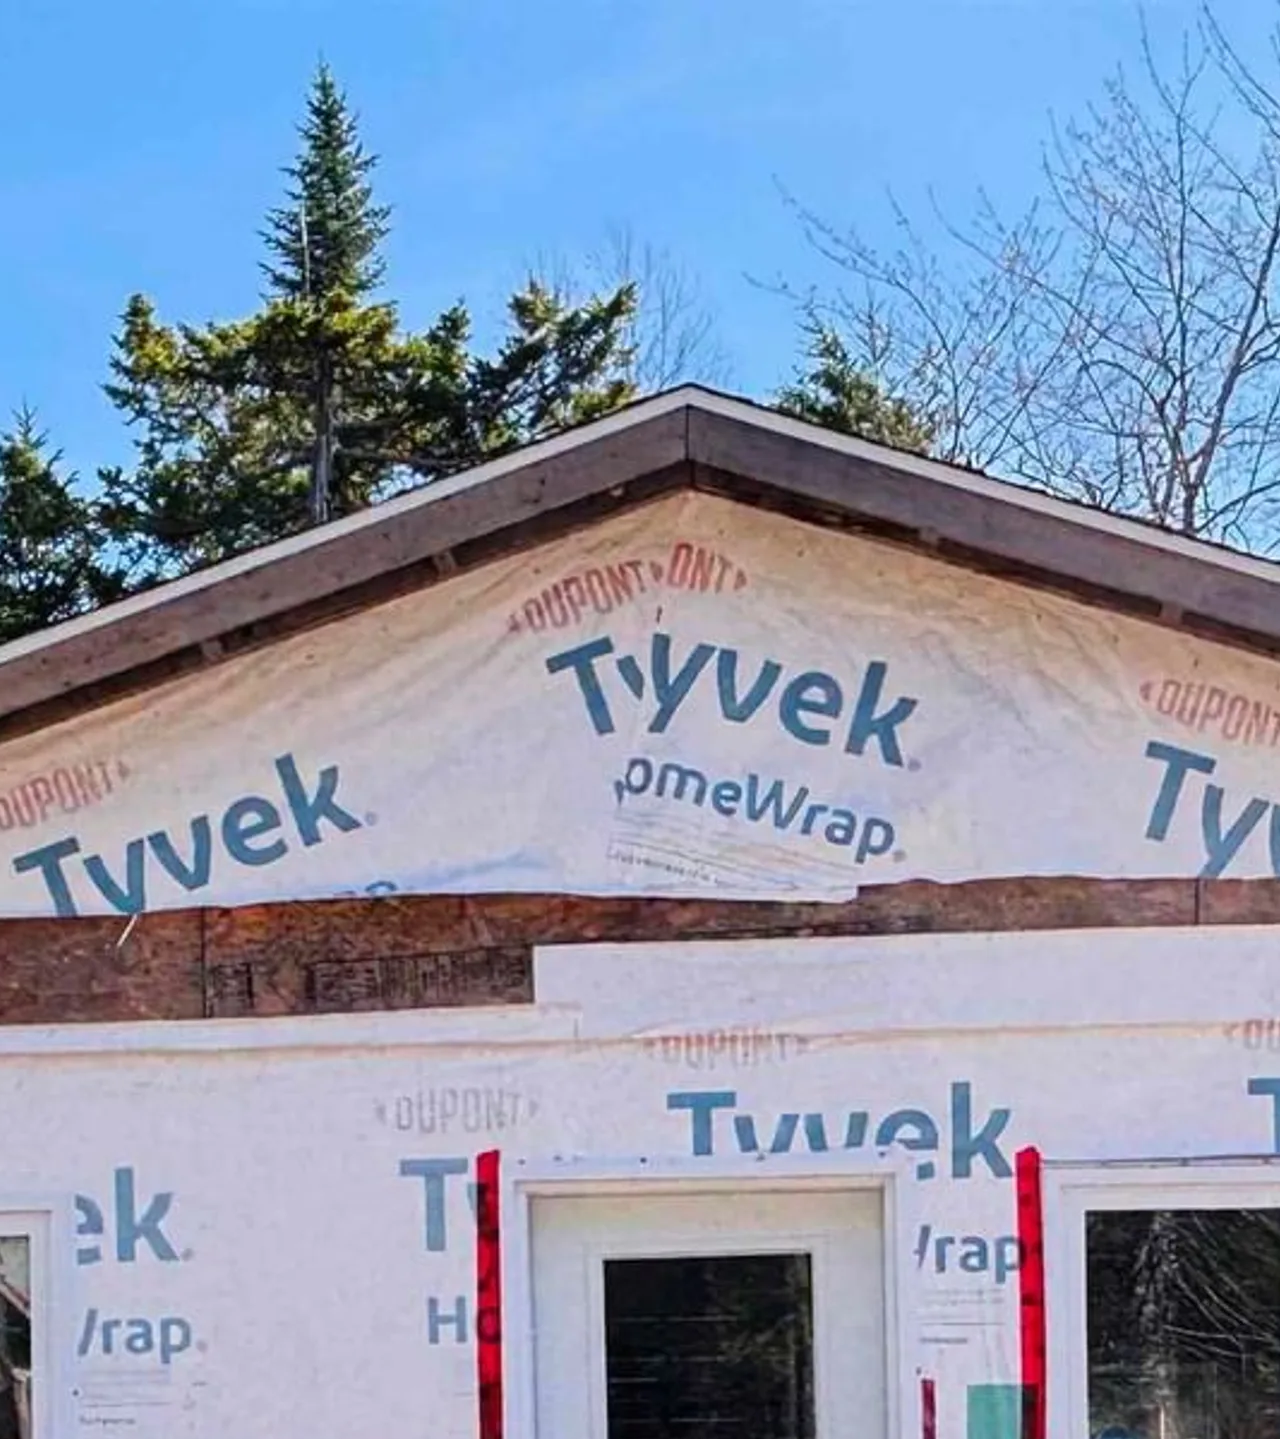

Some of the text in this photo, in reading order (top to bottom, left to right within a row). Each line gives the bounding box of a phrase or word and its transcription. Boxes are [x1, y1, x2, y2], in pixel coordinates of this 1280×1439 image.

[524, 558, 650, 634] DUPONT
[545, 632, 918, 767] Tyvek
[13, 752, 362, 918] Tyvek
[614, 756, 896, 863] omeWrap
[394, 1087, 525, 1133] DUPONT
[915, 1225, 1027, 1284] rap
[77, 1308, 192, 1364] rap
